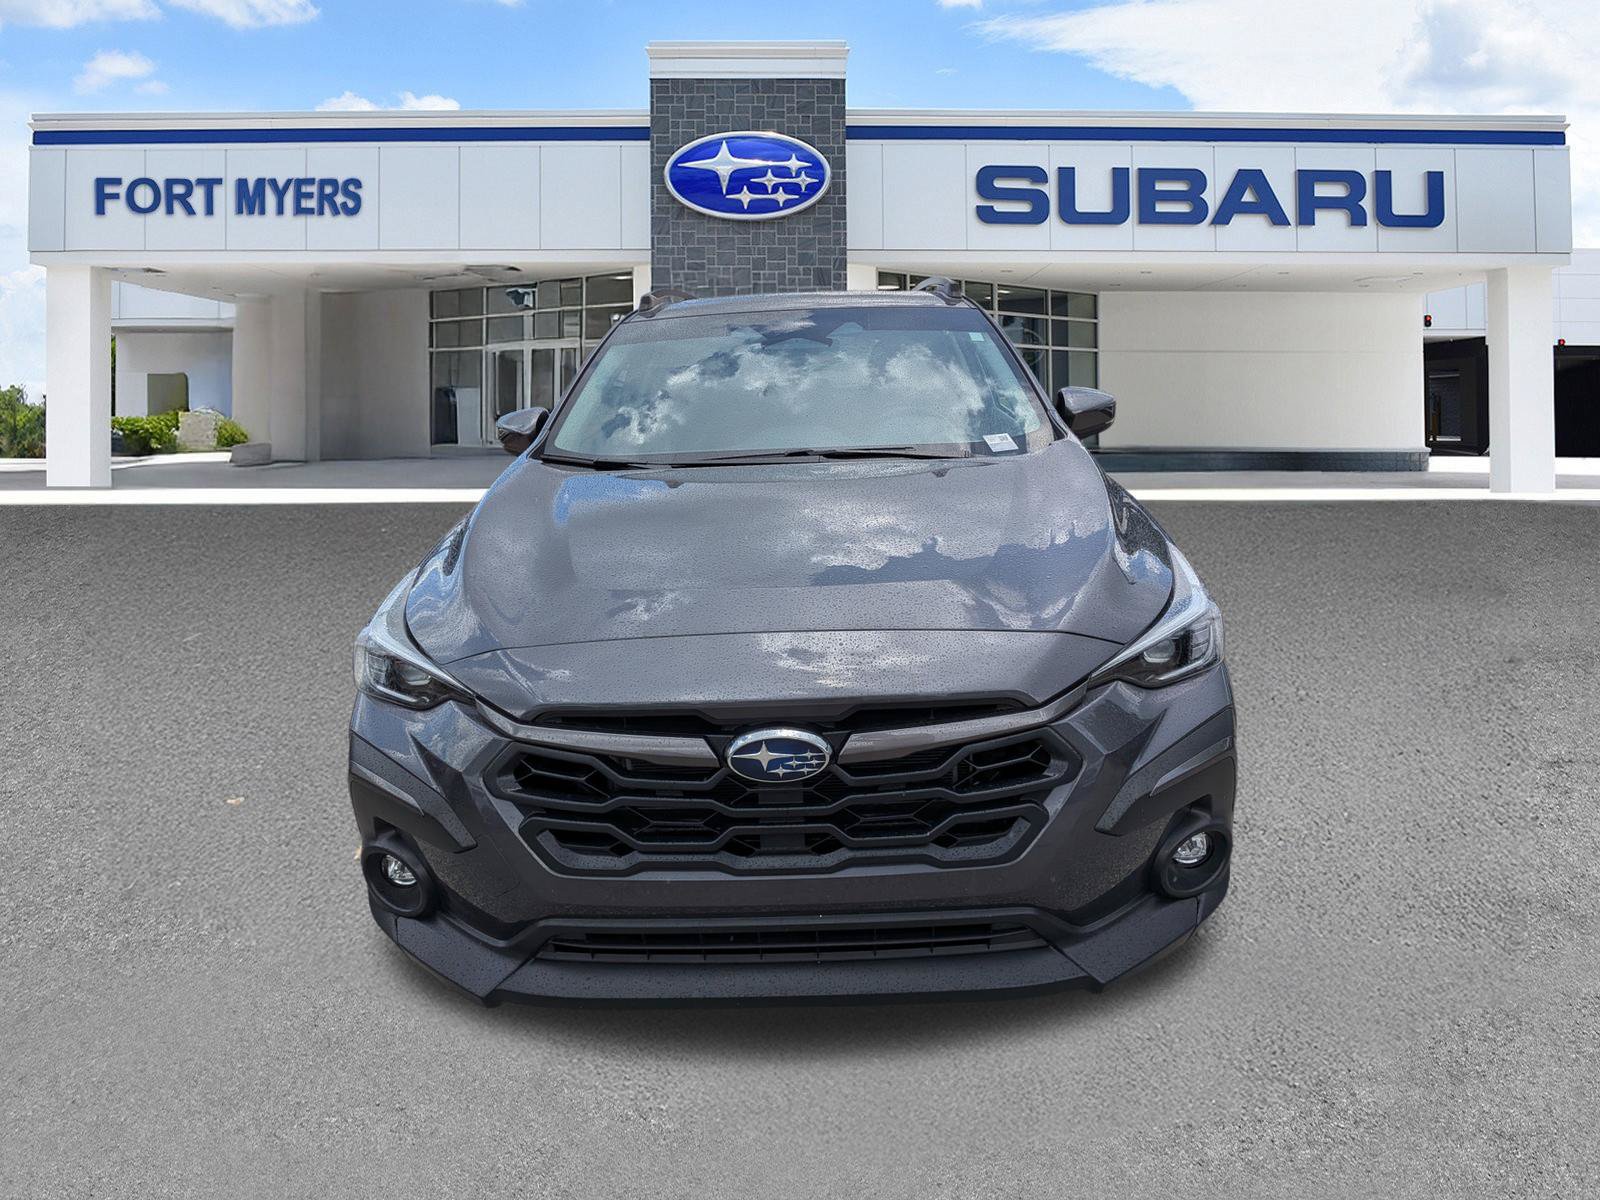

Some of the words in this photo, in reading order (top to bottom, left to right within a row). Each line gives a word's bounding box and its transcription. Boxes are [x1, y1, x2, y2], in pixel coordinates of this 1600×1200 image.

[95, 177, 223, 216] FORT
[235, 177, 363, 217] MYERS
[975, 165, 1446, 228] SUBARU
